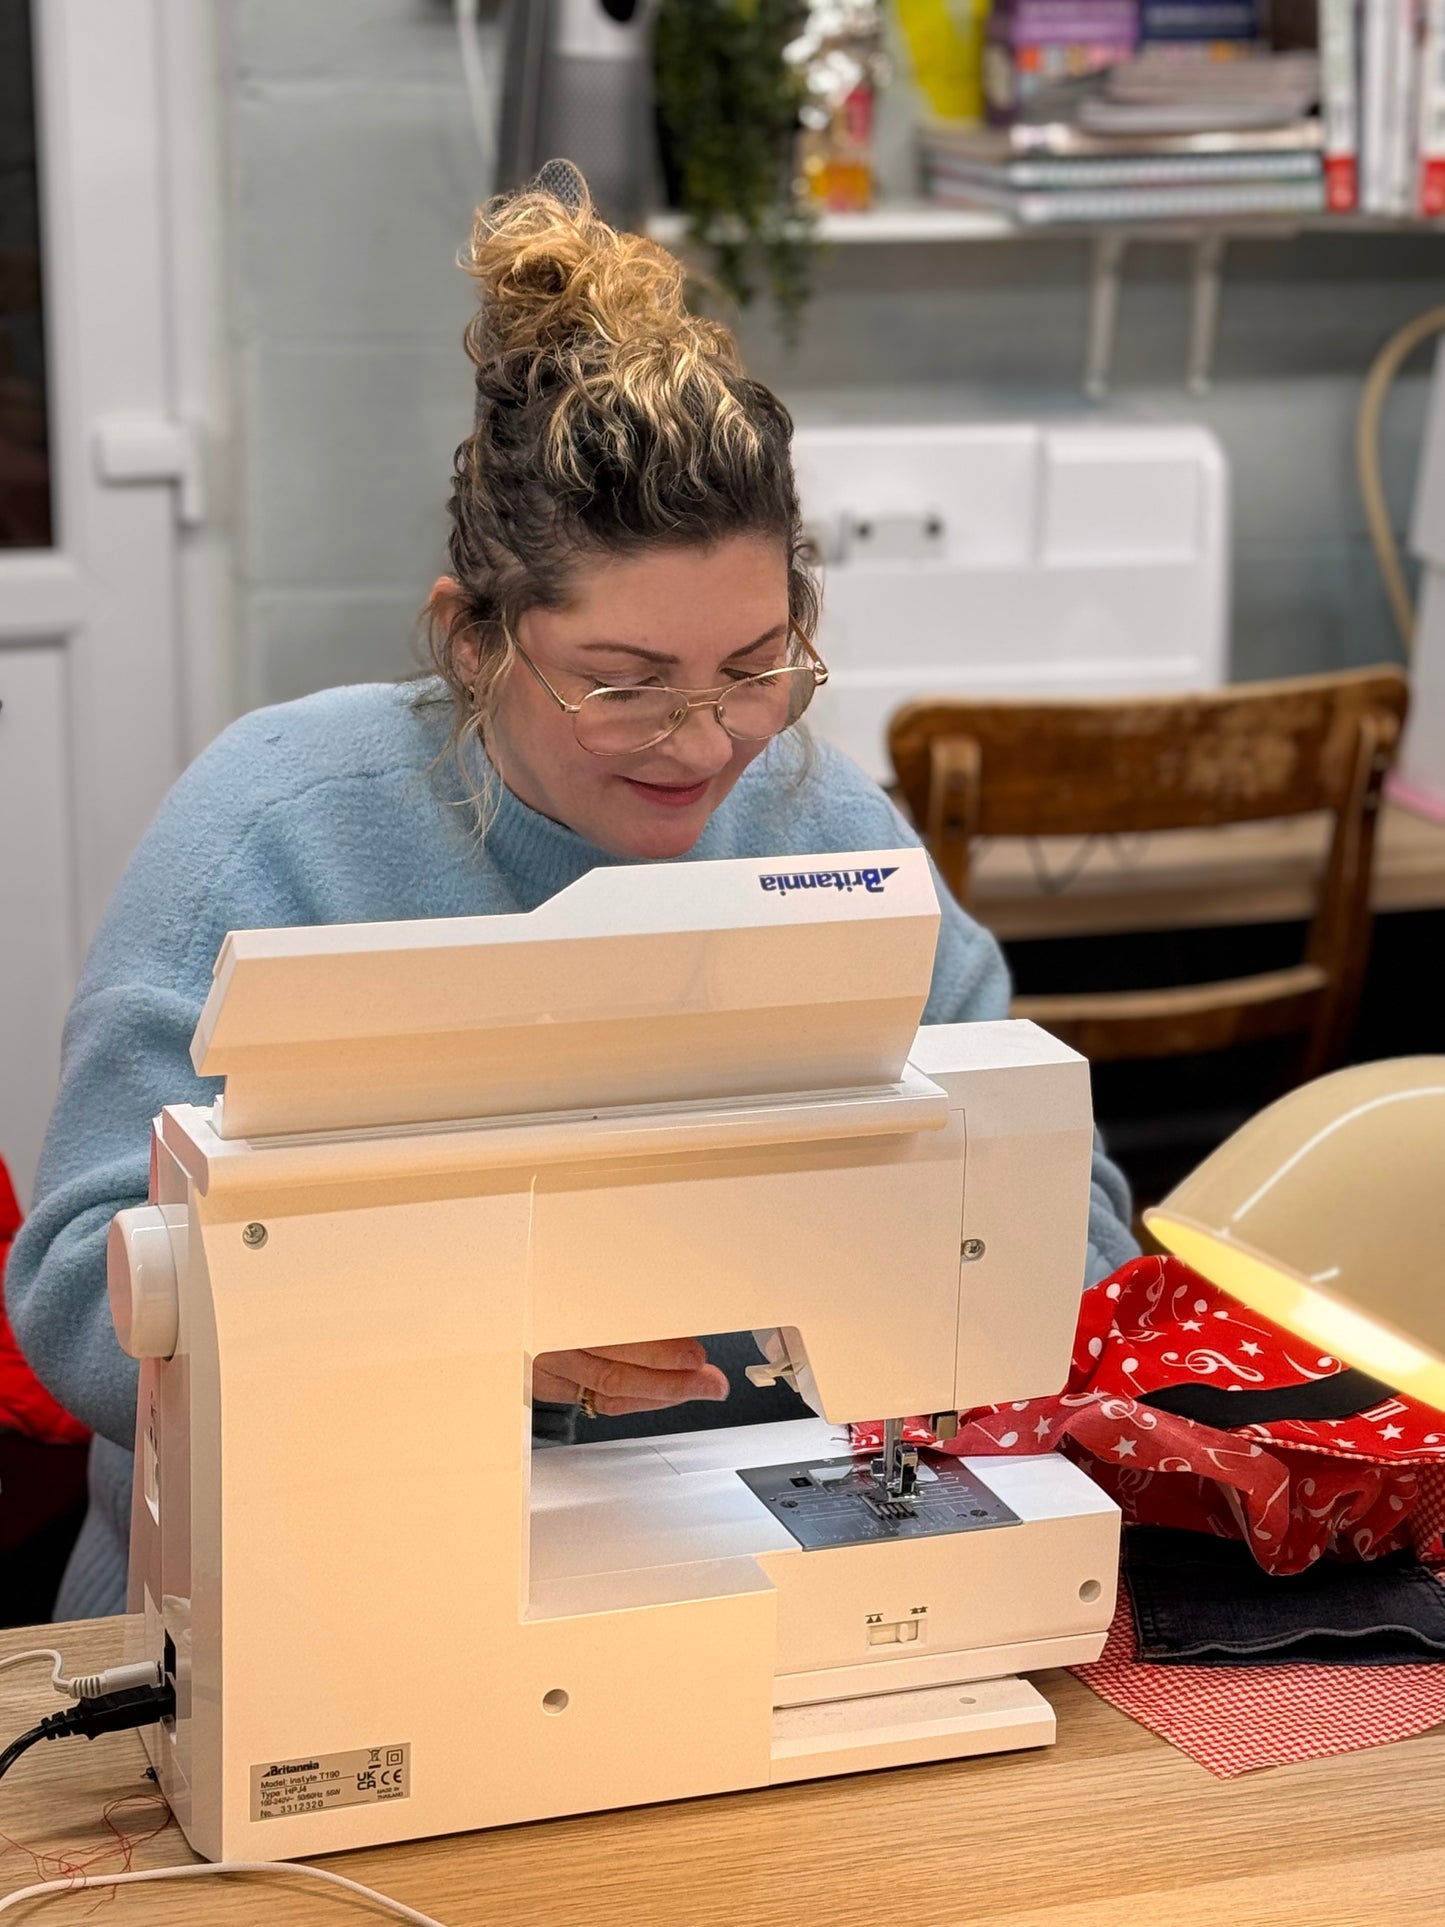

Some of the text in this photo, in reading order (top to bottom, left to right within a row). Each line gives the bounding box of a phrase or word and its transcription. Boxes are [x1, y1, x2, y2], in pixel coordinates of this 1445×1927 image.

[760, 868, 885, 896] Britannia
[269, 1761, 319, 1777] Britannia
[280, 1799, 324, 1814] 3312320
